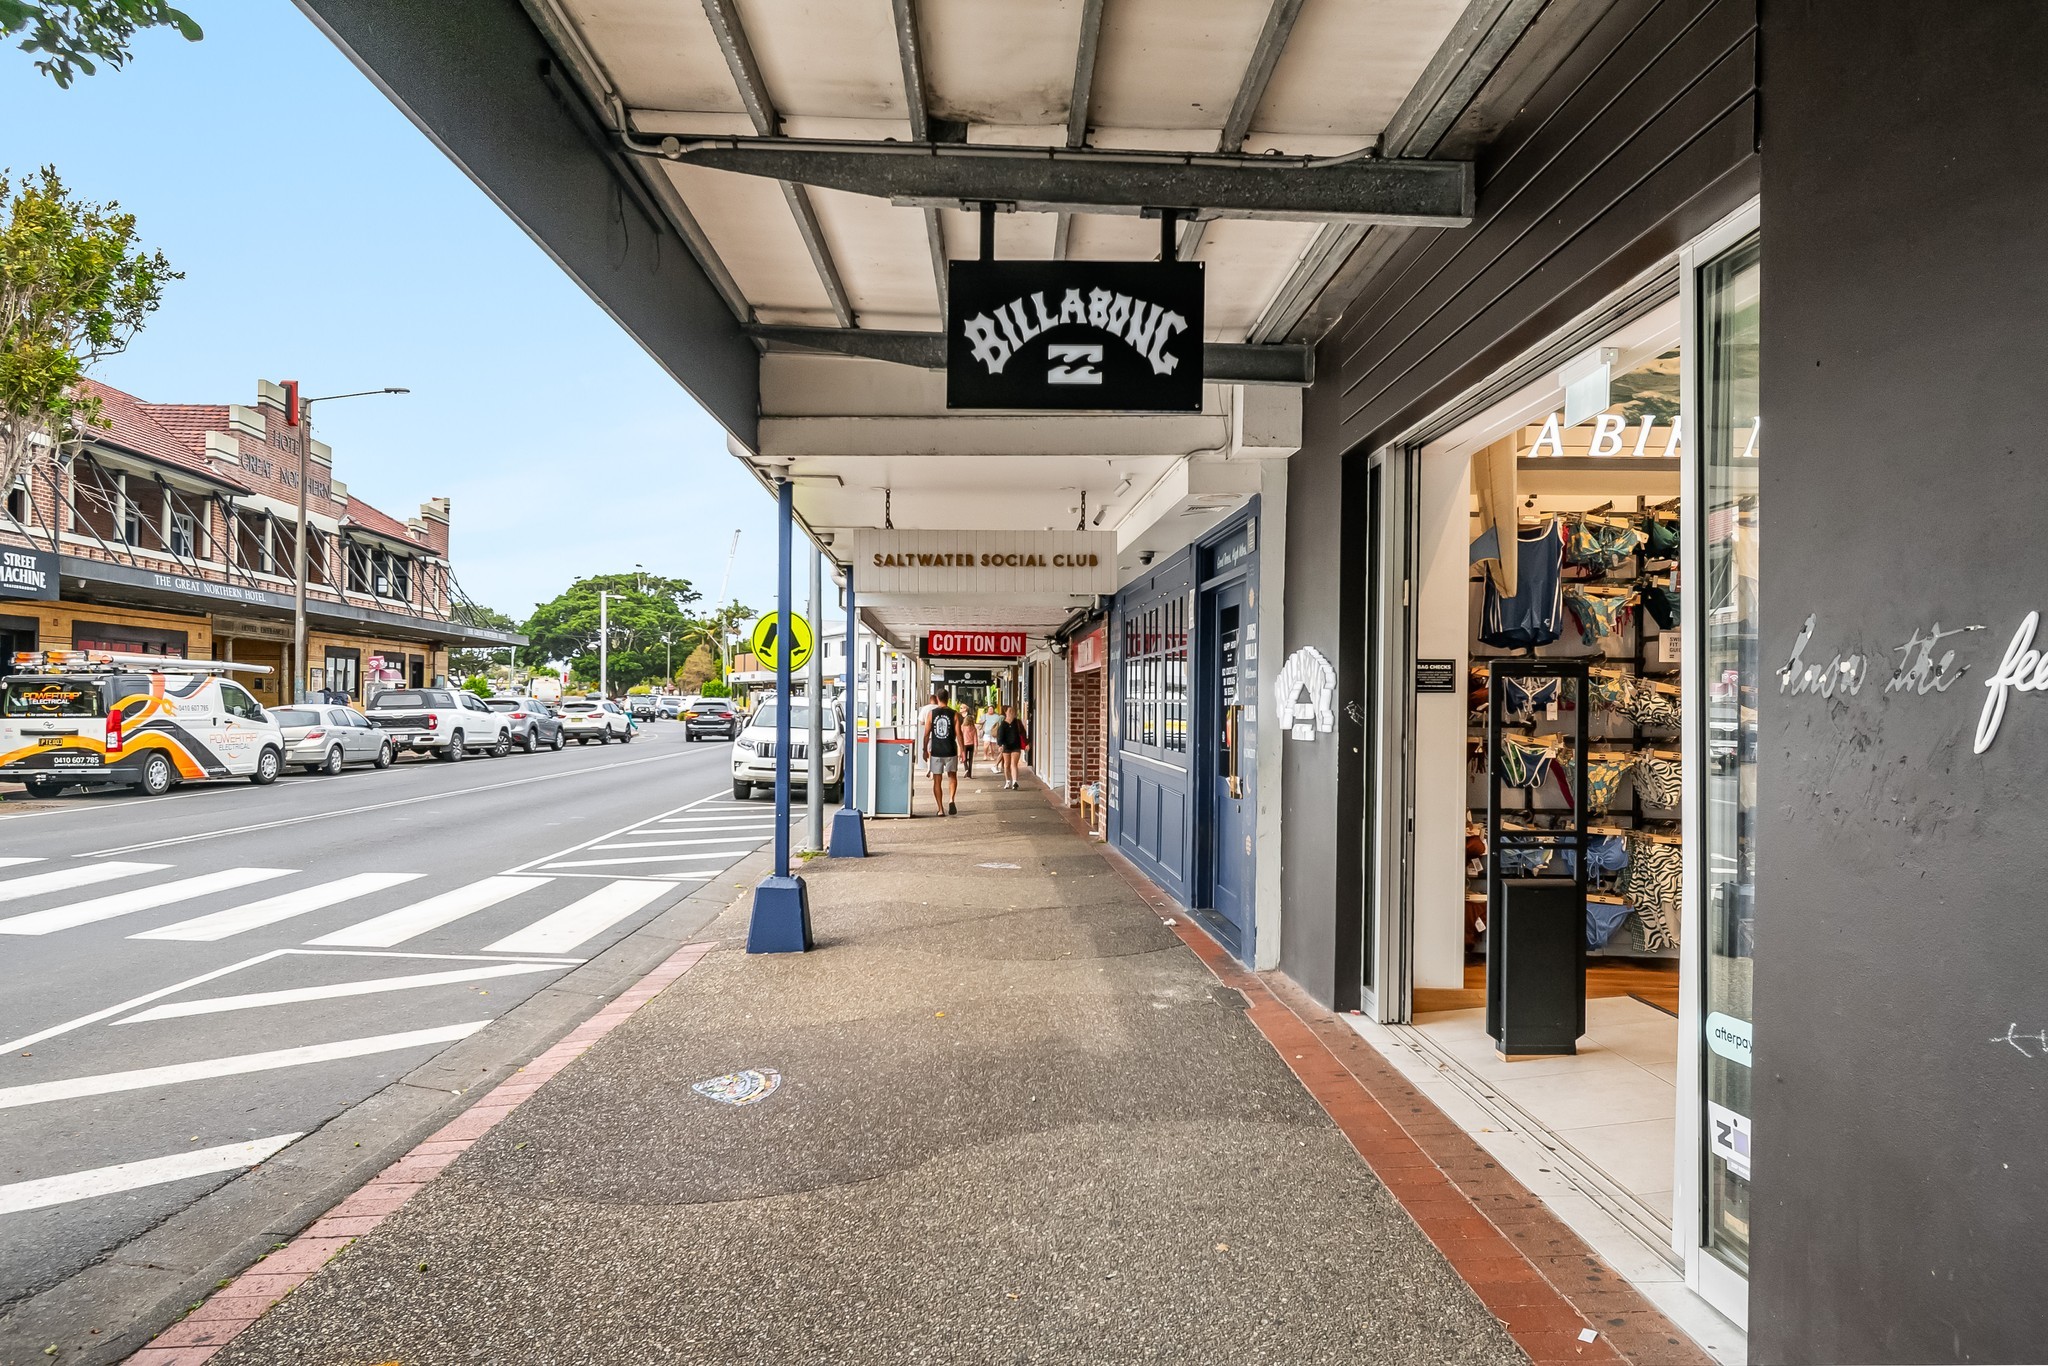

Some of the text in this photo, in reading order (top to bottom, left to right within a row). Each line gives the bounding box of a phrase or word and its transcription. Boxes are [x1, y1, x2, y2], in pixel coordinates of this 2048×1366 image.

[963, 286, 1188, 376] BILLABONG
[273, 430, 300, 456] HOTE
[1527, 412, 1564, 458] A
[241, 453, 331, 500] GREAT NORHERN
[4, 552, 37, 570] STREET
[873, 553, 1099, 568] SALTWATER SOCIAL CLUB
[154, 574, 266, 602] THE GREAT NORTHERN HOTEL
[933, 634, 1021, 653] COTTON ON
